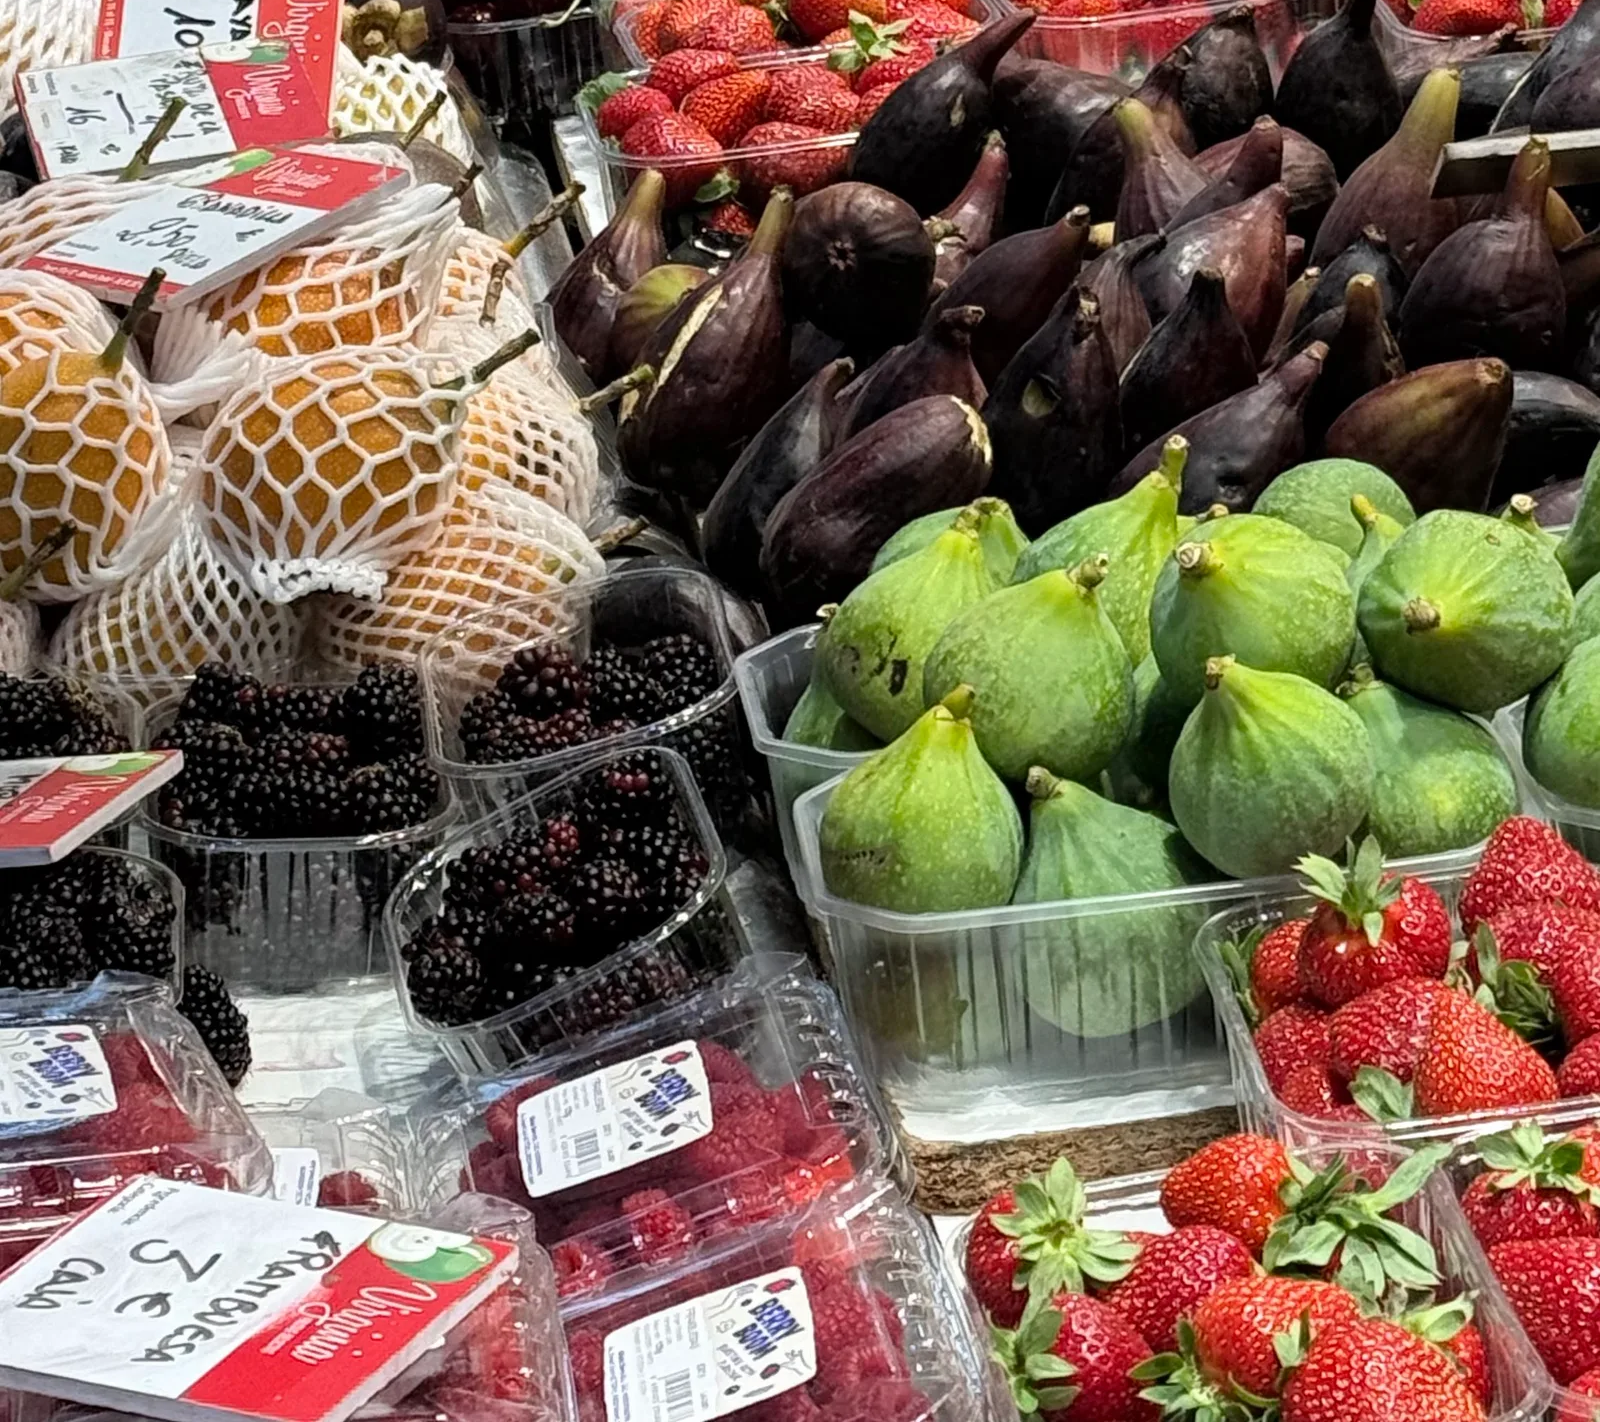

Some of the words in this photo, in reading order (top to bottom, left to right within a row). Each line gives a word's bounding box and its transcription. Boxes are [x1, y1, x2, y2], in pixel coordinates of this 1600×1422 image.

[163, 5, 217, 49] 10
[27, 1058, 77, 1089] BOOM
[42, 1044, 104, 1079] BERRY
[633, 1088, 678, 1123] BOOM
[648, 1067, 702, 1106] BERRY
[129, 1237, 225, 1283] 3
[114, 1290, 172, 1318] €
[131, 1229, 343, 1364] FRAMBUESA
[295, 1281, 439, 1366] Virginia
[748, 1296, 806, 1343] BERRY
[732, 1322, 779, 1362] BOOM
